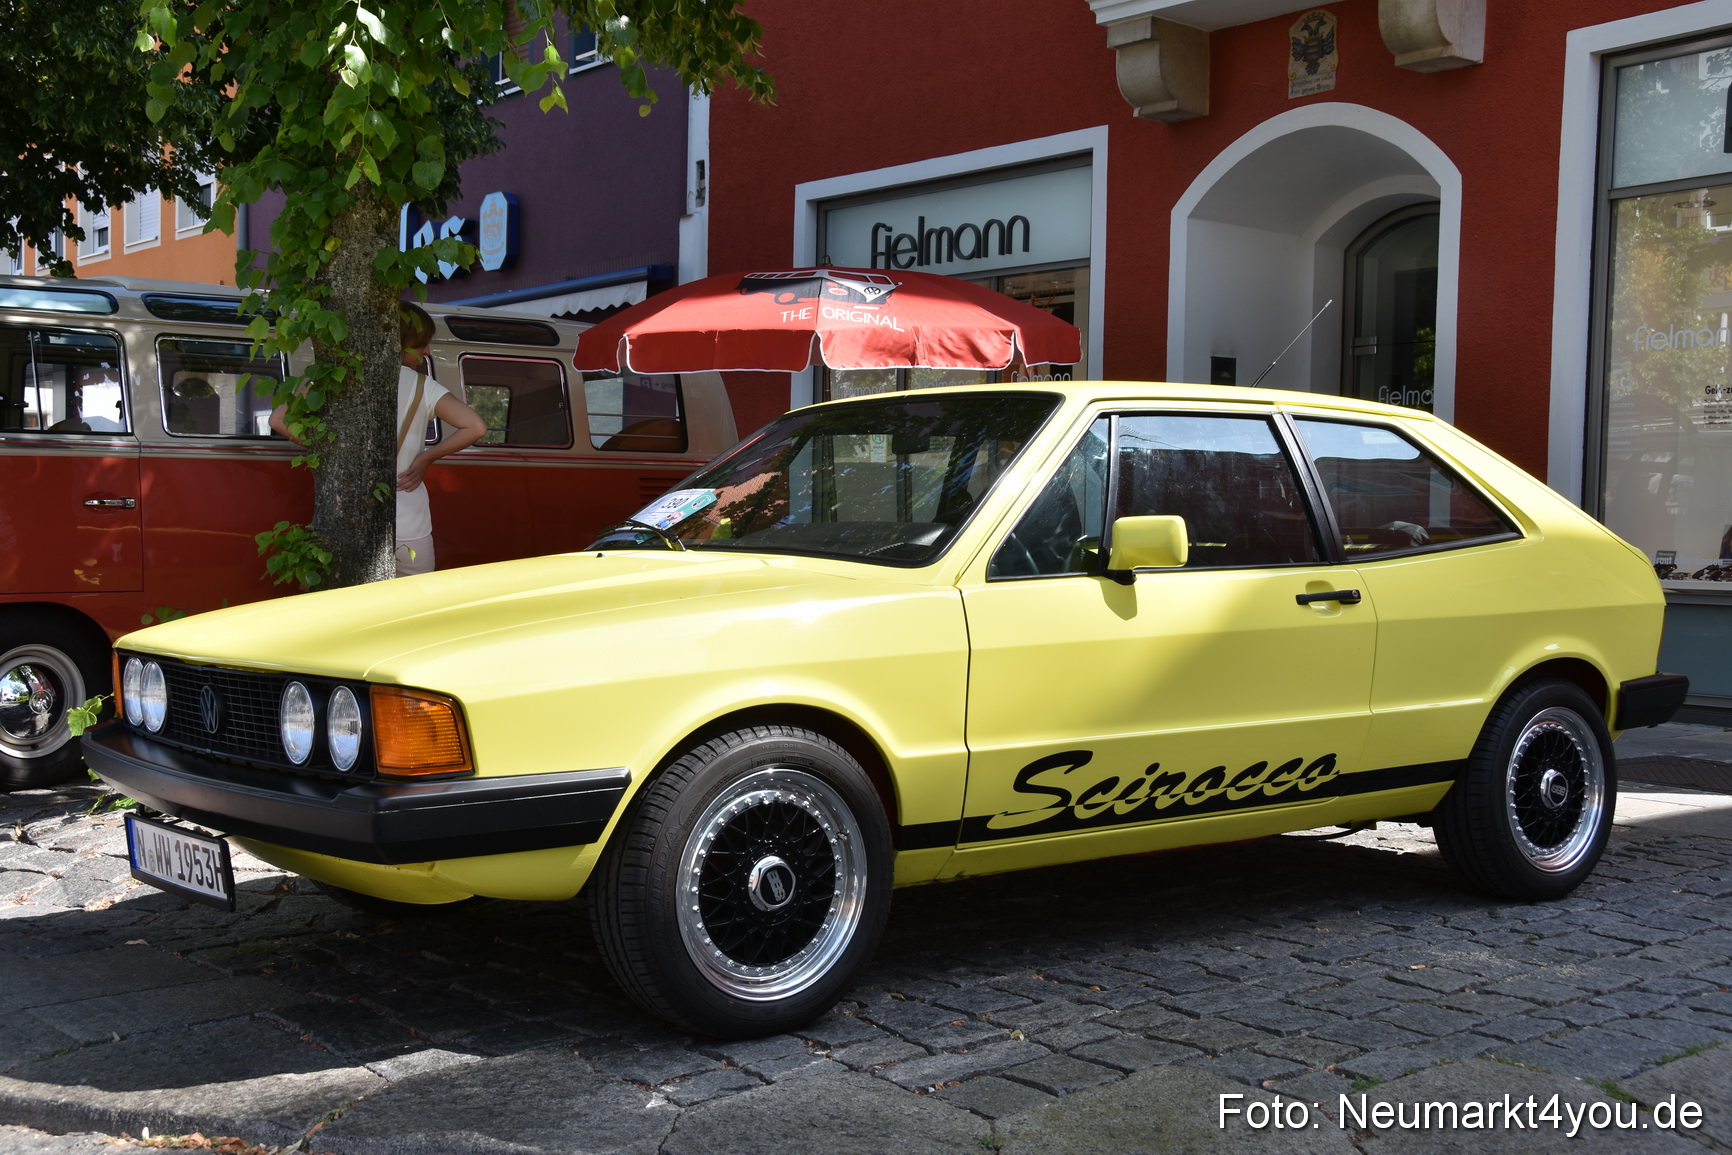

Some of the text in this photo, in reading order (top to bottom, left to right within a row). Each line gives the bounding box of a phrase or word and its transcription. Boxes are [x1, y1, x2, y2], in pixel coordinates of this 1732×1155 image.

[871, 215, 1030, 269] fielmann
[780, 306, 905, 333] THE ORIGINAL
[986, 749, 1340, 830] Scirocco
